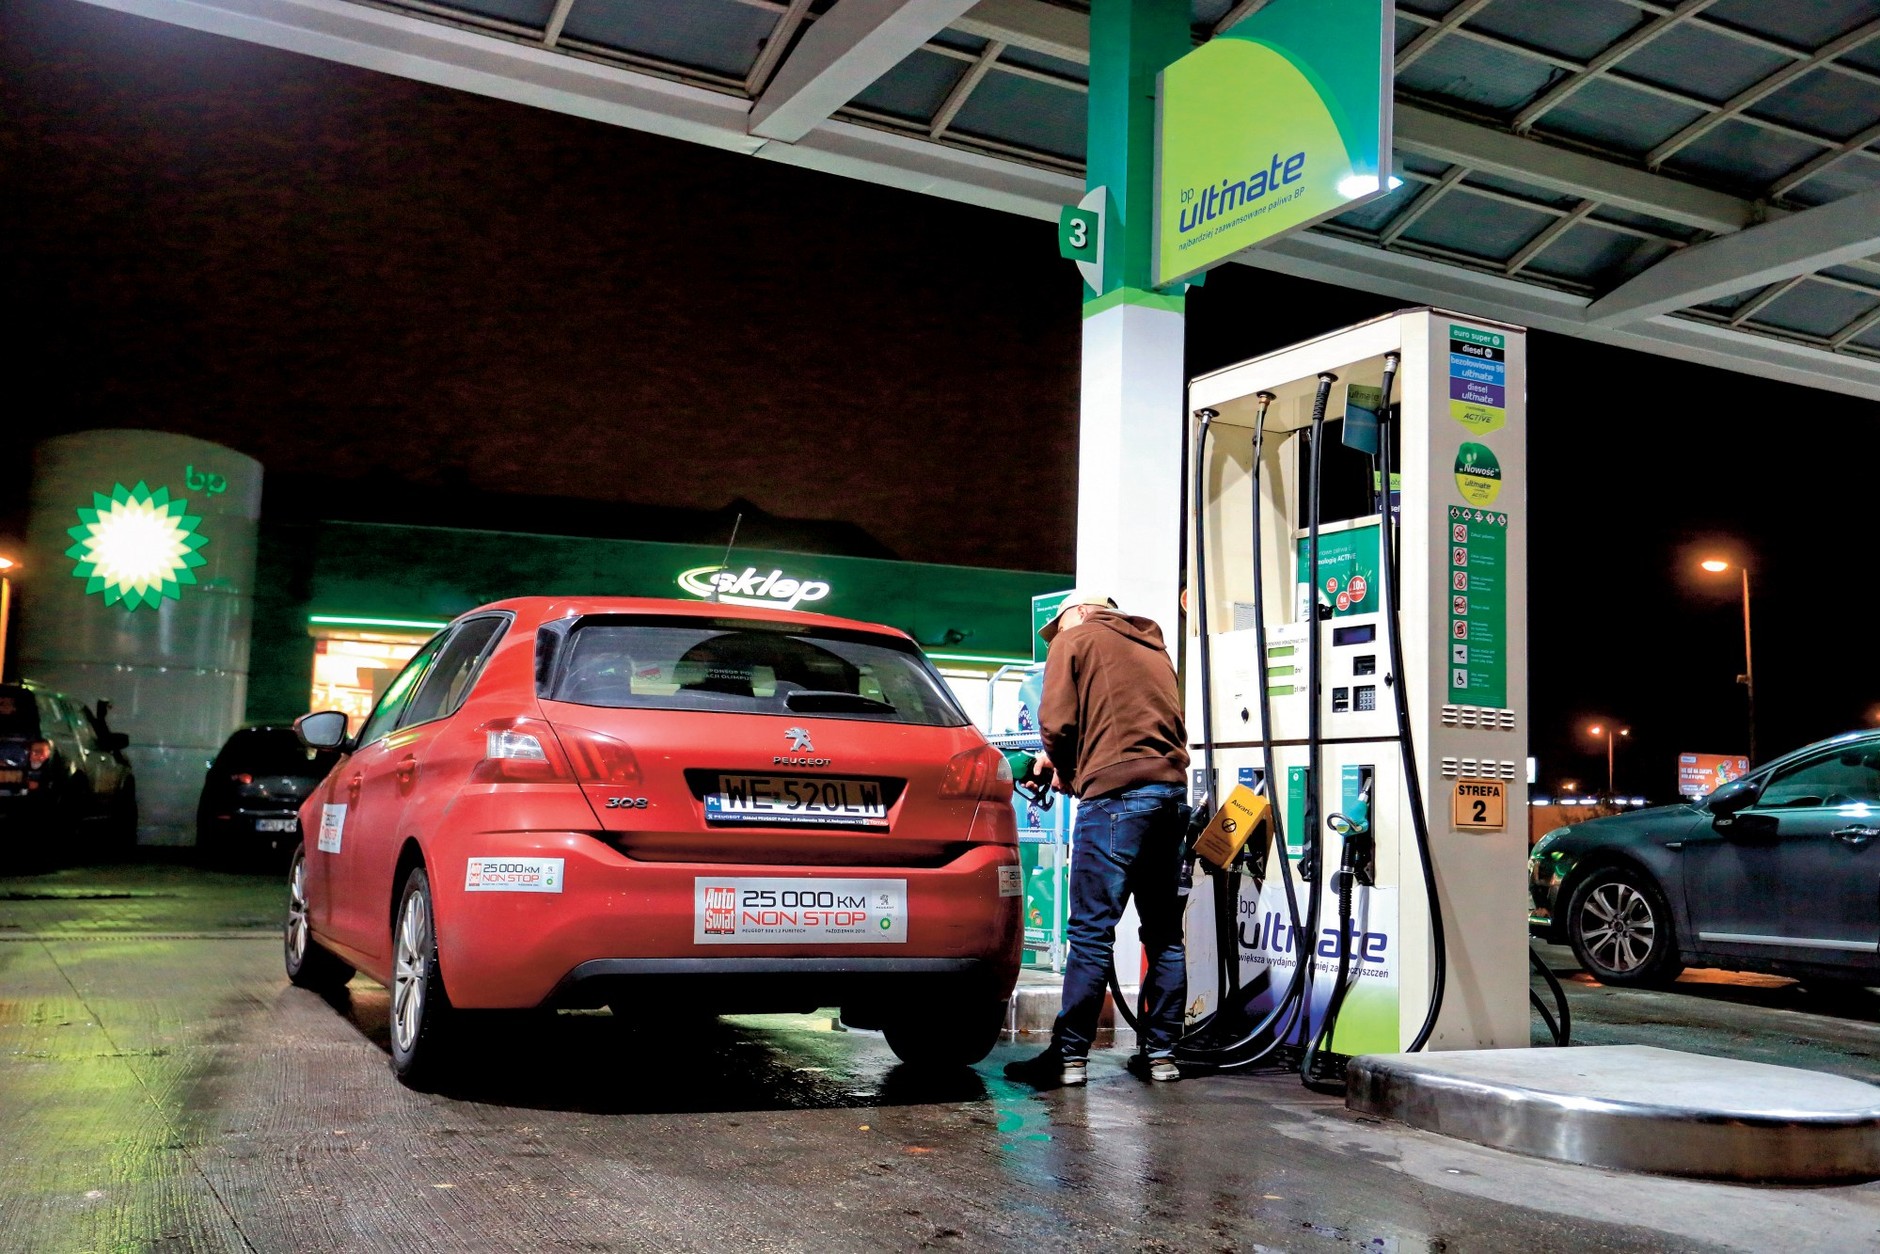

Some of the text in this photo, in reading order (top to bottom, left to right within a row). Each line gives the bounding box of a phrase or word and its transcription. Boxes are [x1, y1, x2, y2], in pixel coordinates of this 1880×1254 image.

[1179, 151, 1306, 233] ultimate
[1180, 187, 1195, 204] bp
[1178, 186, 1305, 251] najbardziej zaawansowane paliwa BP
[1068, 217, 1088, 248] 3
[1453, 330, 1470, 339] euro
[1471, 333, 1491, 343] super
[1462, 344, 1484, 356] diesel
[1461, 369, 1494, 382] ultimate
[1467, 382, 1488, 394] diesel
[1461, 391, 1494, 404] ultimate
[1463, 412, 1493, 424] ACTIVE
[186, 465, 227, 497] bp
[709, 567, 830, 610] sklep
[773, 756, 832, 766] PEUGEOT
[725, 778, 880, 814] WE 520LW
[1458, 785, 1500, 797] STREFA
[605, 797, 649, 809] 308
[708, 796, 720, 806] PL
[1231, 799, 1254, 817] Awaria
[1472, 800, 1487, 822] 2
[483, 863, 540, 874] 25 000 KM
[482, 874, 540, 882] NON STOP
[705, 888, 735, 909] Auto
[743, 890, 866, 908] 25 000 KM
[1239, 895, 1257, 918] bp
[742, 911, 867, 926] NON STOP
[1239, 953, 1265, 964] większa
